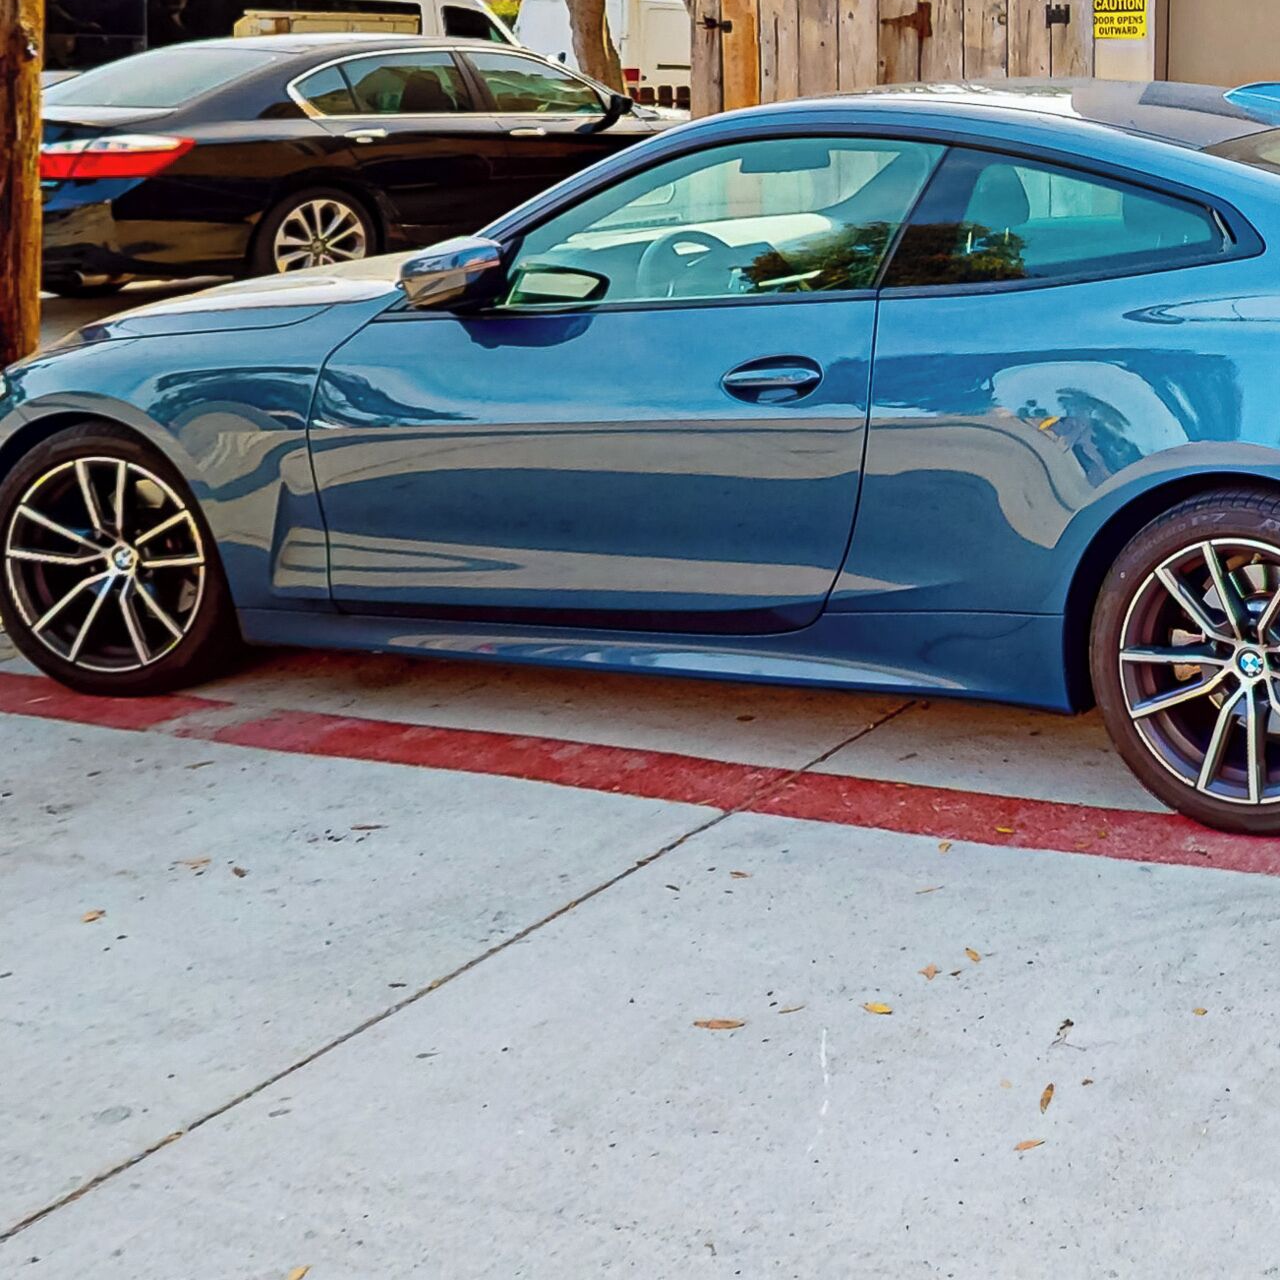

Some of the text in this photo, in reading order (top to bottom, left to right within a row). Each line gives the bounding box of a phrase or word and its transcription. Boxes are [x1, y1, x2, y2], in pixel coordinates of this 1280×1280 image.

[1093, 15, 1143, 24] DOOR OPENS
[1099, 26, 1138, 35] OUTWARD
